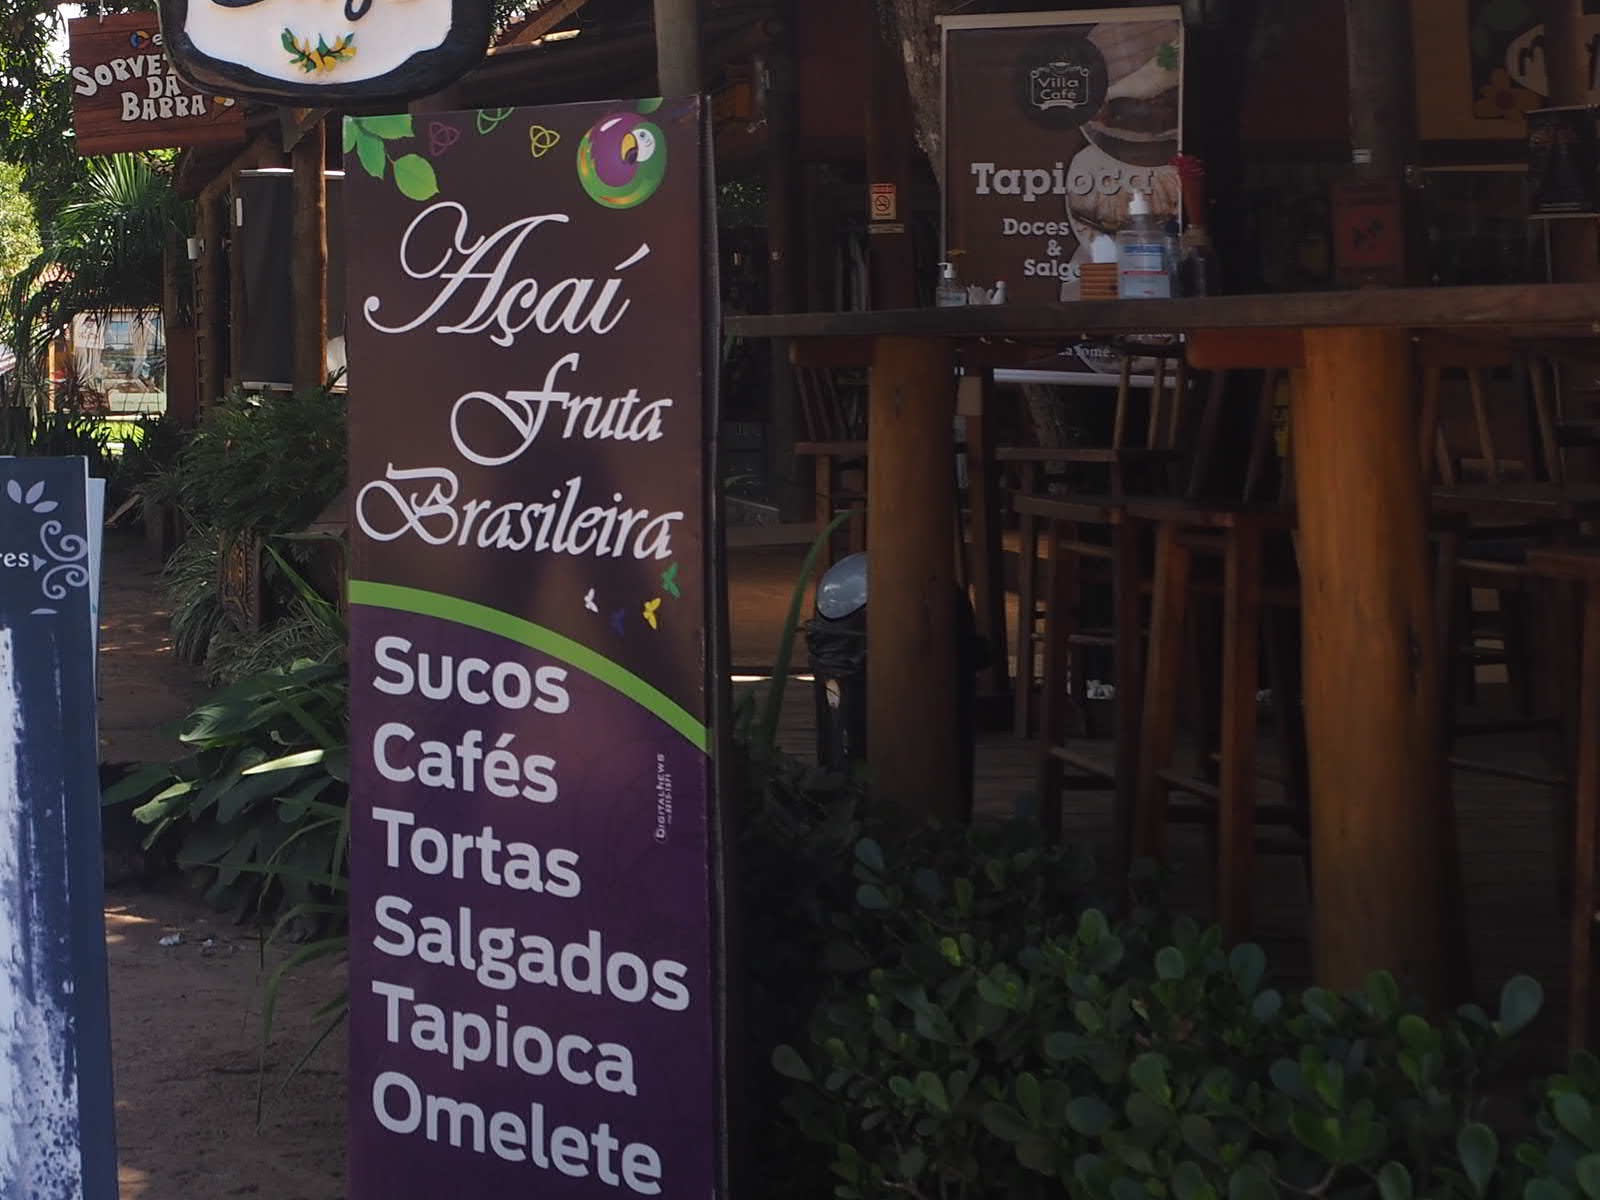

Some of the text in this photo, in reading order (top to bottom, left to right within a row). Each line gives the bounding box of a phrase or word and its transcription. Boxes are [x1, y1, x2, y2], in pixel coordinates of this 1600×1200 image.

[121, 92, 207, 121] BARRA
[147, 76, 181, 98] DA
[1038, 77, 1079, 88] Villa
[1040, 89, 1077, 100] Café
[970, 162, 1155, 202] Tapioca
[1002, 218, 1070, 235] Doces
[1047, 239, 1063, 256] &
[362, 200, 651, 348] Açaí
[355, 461, 684, 561] Brasileira
[372, 635, 570, 715] Sucos
[372, 722, 560, 804] Cafés
[371, 807, 582, 899] Tortas
[371, 895, 691, 1011] Salgados
[371, 980, 638, 1097] Tapioca
[371, 1070, 664, 1195] Omelete
